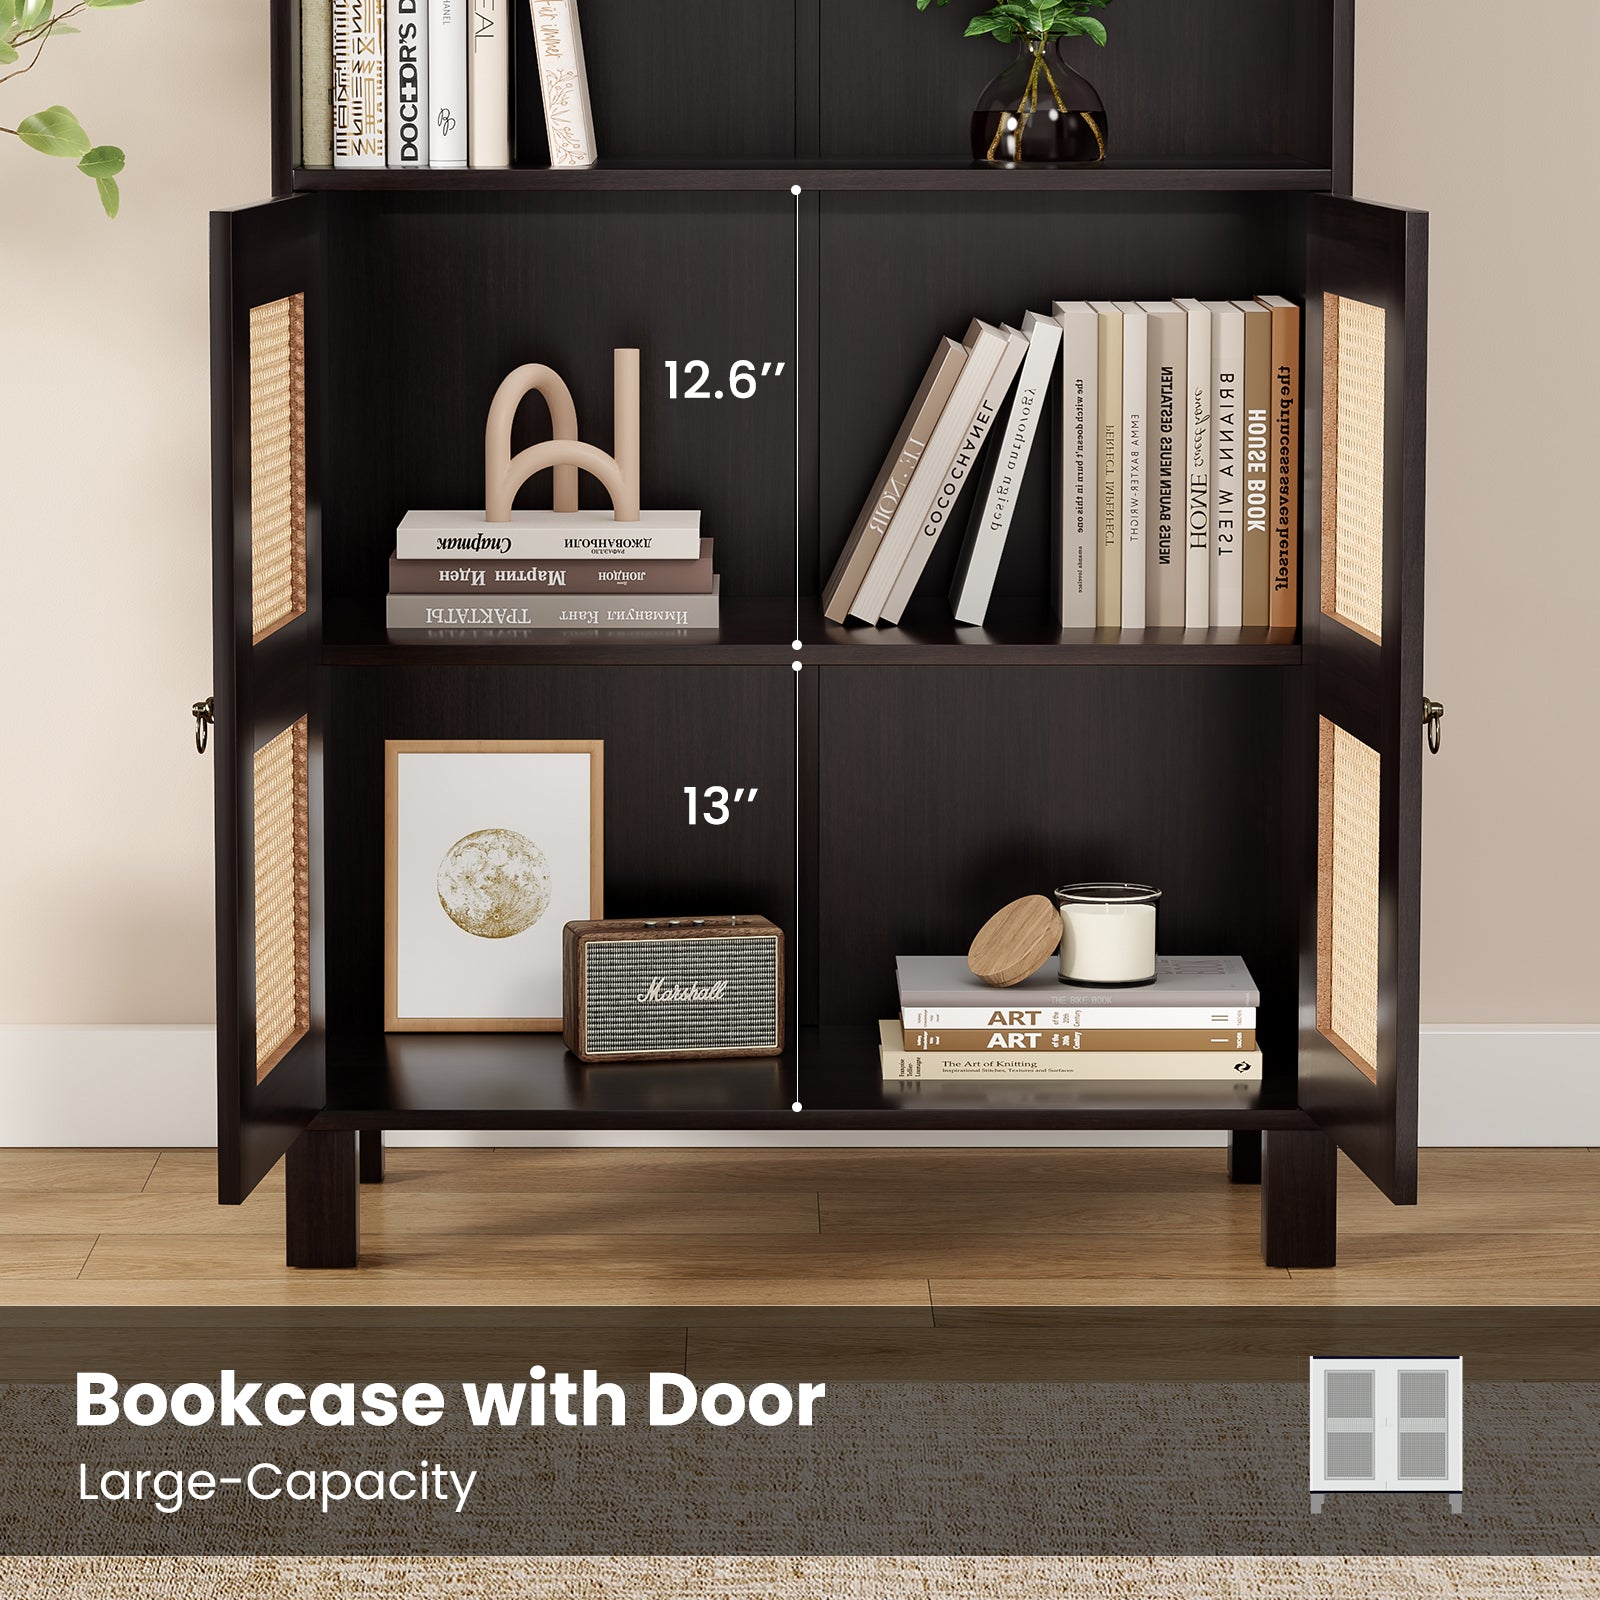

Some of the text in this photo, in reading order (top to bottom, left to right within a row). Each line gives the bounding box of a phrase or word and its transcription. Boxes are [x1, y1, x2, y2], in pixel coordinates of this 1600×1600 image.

[437, 533, 512, 553] Спартак
[564, 538, 652, 549] ДЖОВАНЬОЛИ
[439, 568, 566, 586] Мартин Иден
[426, 608, 531, 624] ТРАКТАТЫ
[559, 608, 688, 624] Иммануил Кант
[637, 976, 728, 1002] Marshall
[988, 1011, 1042, 1025] ART
[987, 1033, 1042, 1048] ART
[996, 1061, 1038, 1069] Knitting
